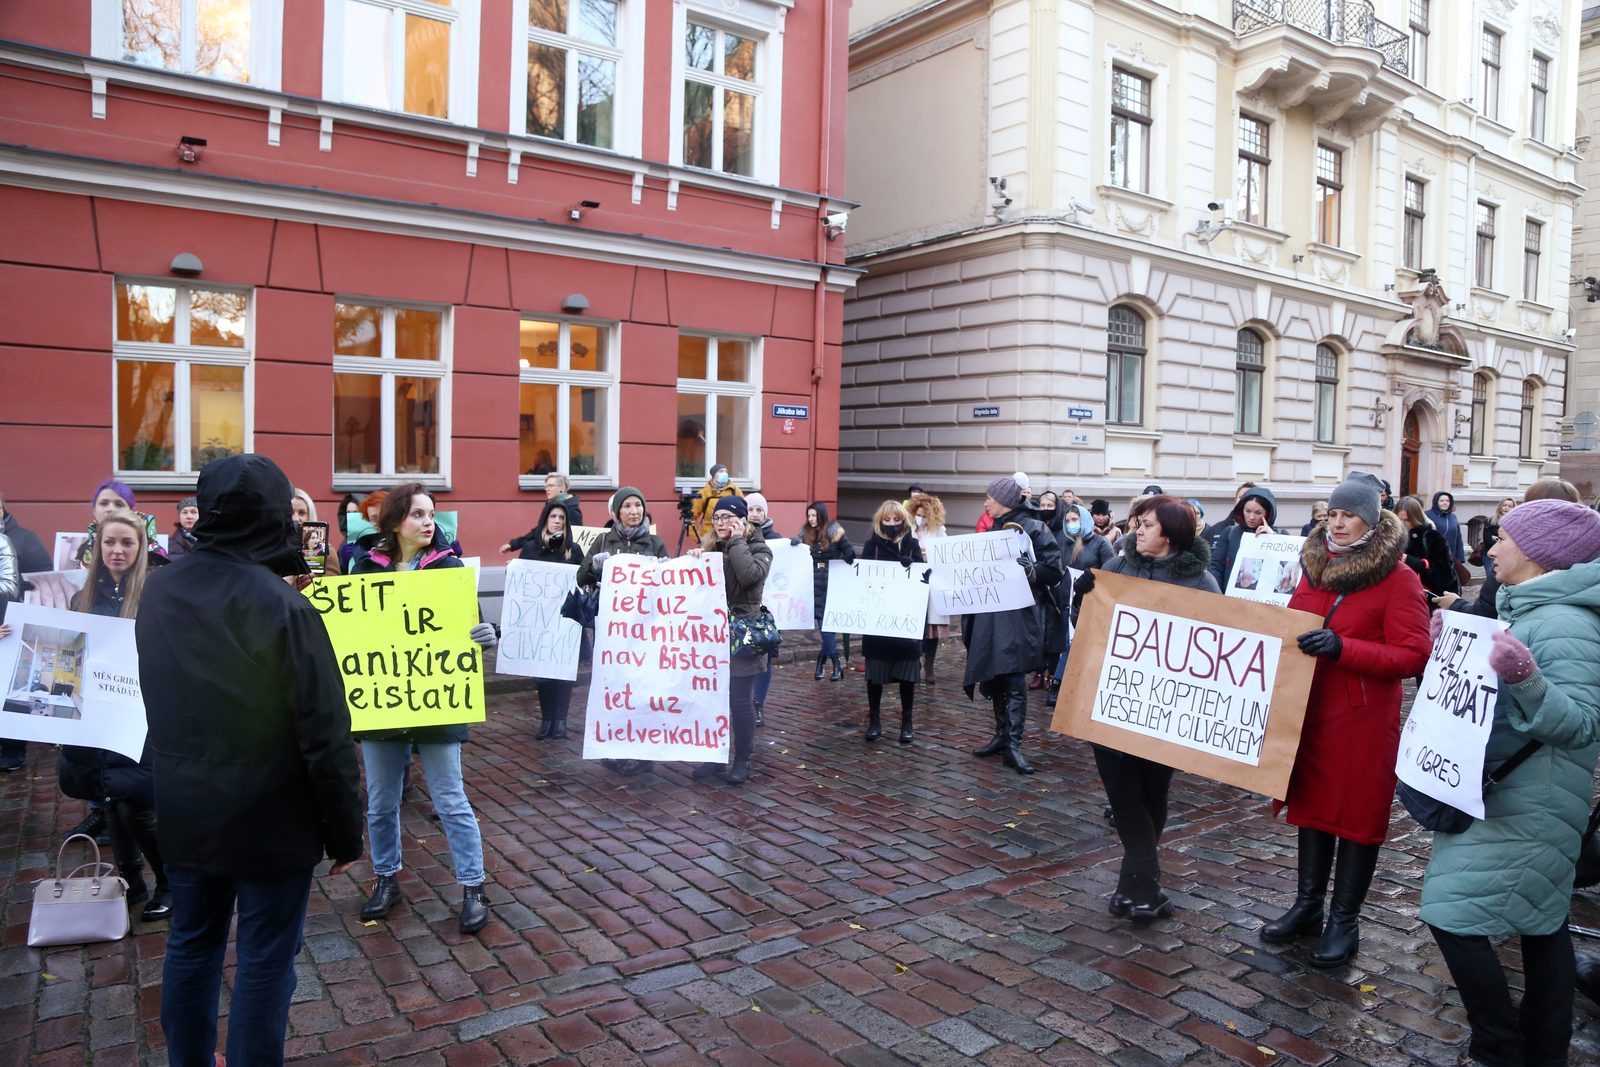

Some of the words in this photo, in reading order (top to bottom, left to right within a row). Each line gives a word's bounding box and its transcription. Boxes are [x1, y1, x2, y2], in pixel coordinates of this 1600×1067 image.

[576, 529, 597, 546] Mē
[1260, 540, 1300, 553] FRIZŪRA
[953, 565, 1006, 587] NAGUS
[612, 587, 650, 615] iet
[656, 595, 688, 616] uz
[939, 586, 1001, 609] TAUTAI
[342, 643, 479, 678] anikira
[601, 649, 647, 668] nav
[1111, 610, 1266, 692] BAUSKA
[93, 670, 112, 682] MĒS
[113, 674, 139, 687] GRIBA
[692, 672, 718, 692] mi
[348, 676, 474, 712] eistari
[604, 683, 636, 711] iet
[649, 695, 683, 714] uz
[1106, 664, 1144, 698] PAR
[1149, 675, 1233, 721] KOPTIEM
[1240, 697, 1269, 730] UN
[1099, 690, 1173, 734] VESELIEM
[1177, 712, 1264, 758] CILVĒKIEM
[1415, 745, 1461, 788] OGRES
